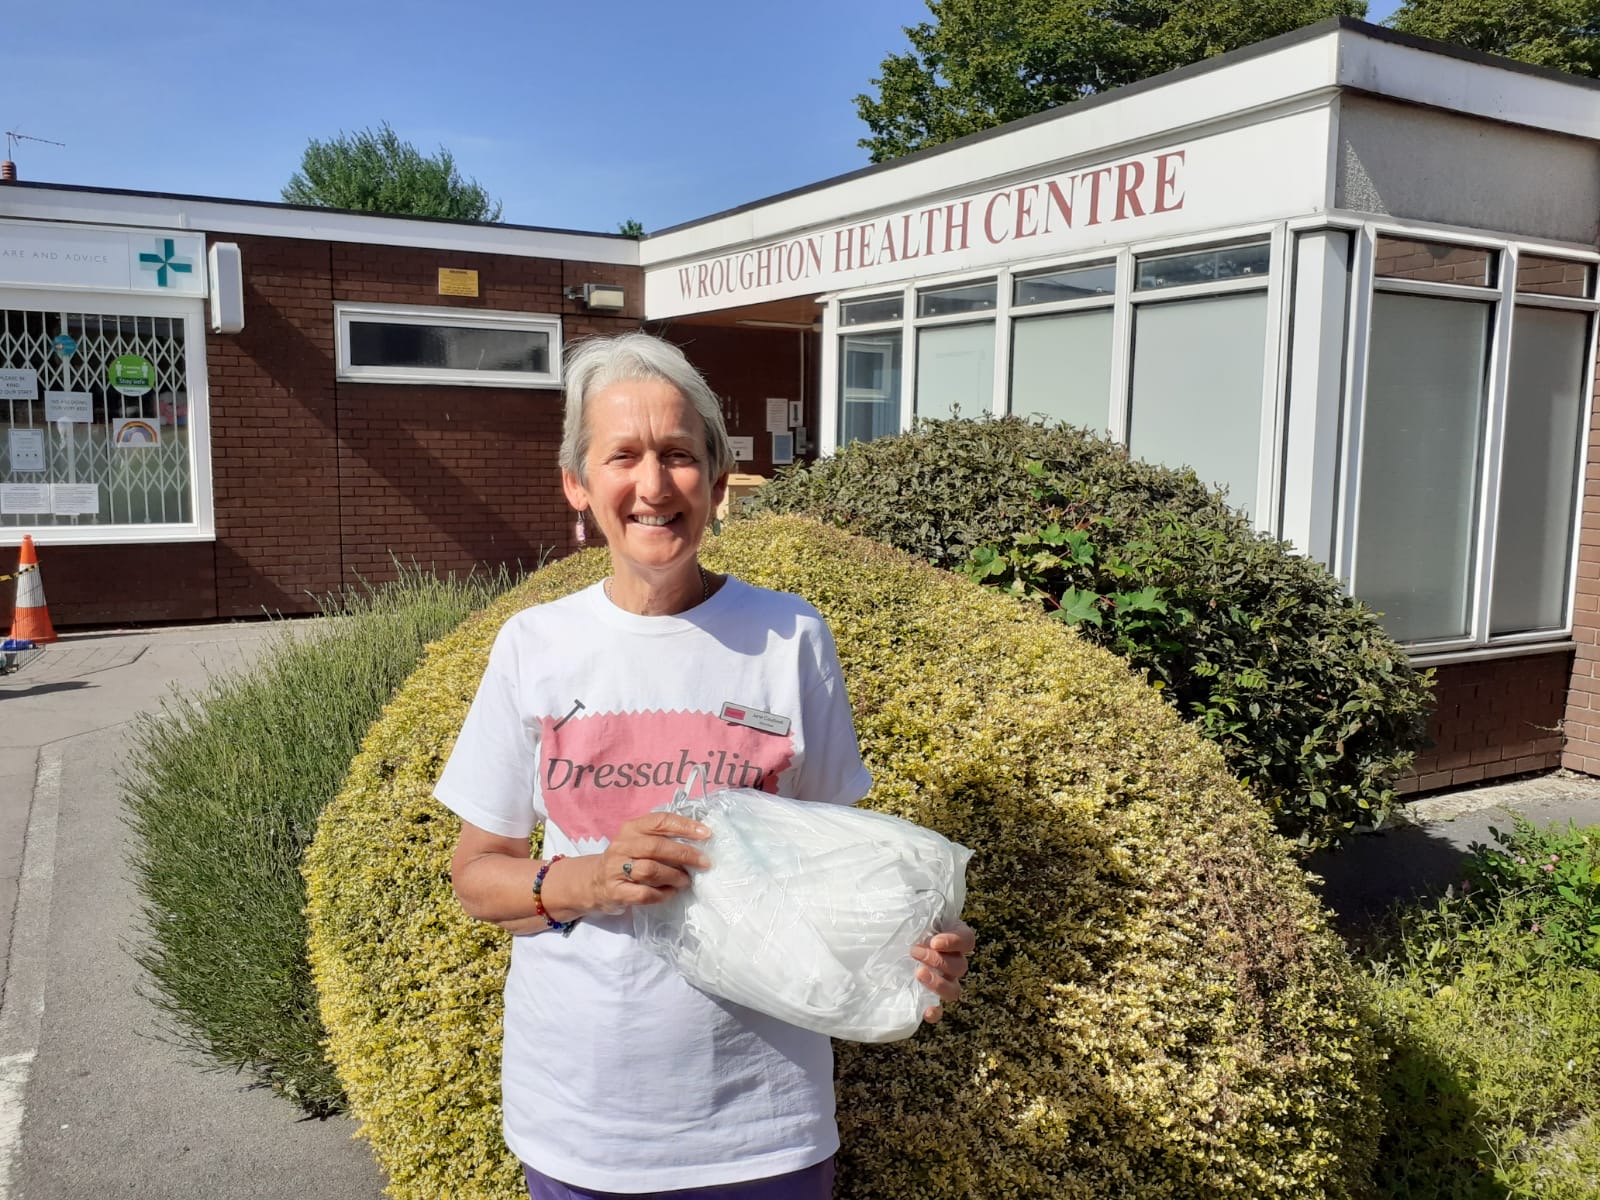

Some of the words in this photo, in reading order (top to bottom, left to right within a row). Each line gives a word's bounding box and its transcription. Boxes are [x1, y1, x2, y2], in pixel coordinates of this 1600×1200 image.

[678, 235, 824, 301] WROUGHTON
[832, 200, 973, 273] HEALTH
[984, 150, 1185, 245] CENTRE
[32, 251, 58, 261] AND
[65, 253, 109, 264] ADVICE
[547, 749, 774, 791] Dressability
